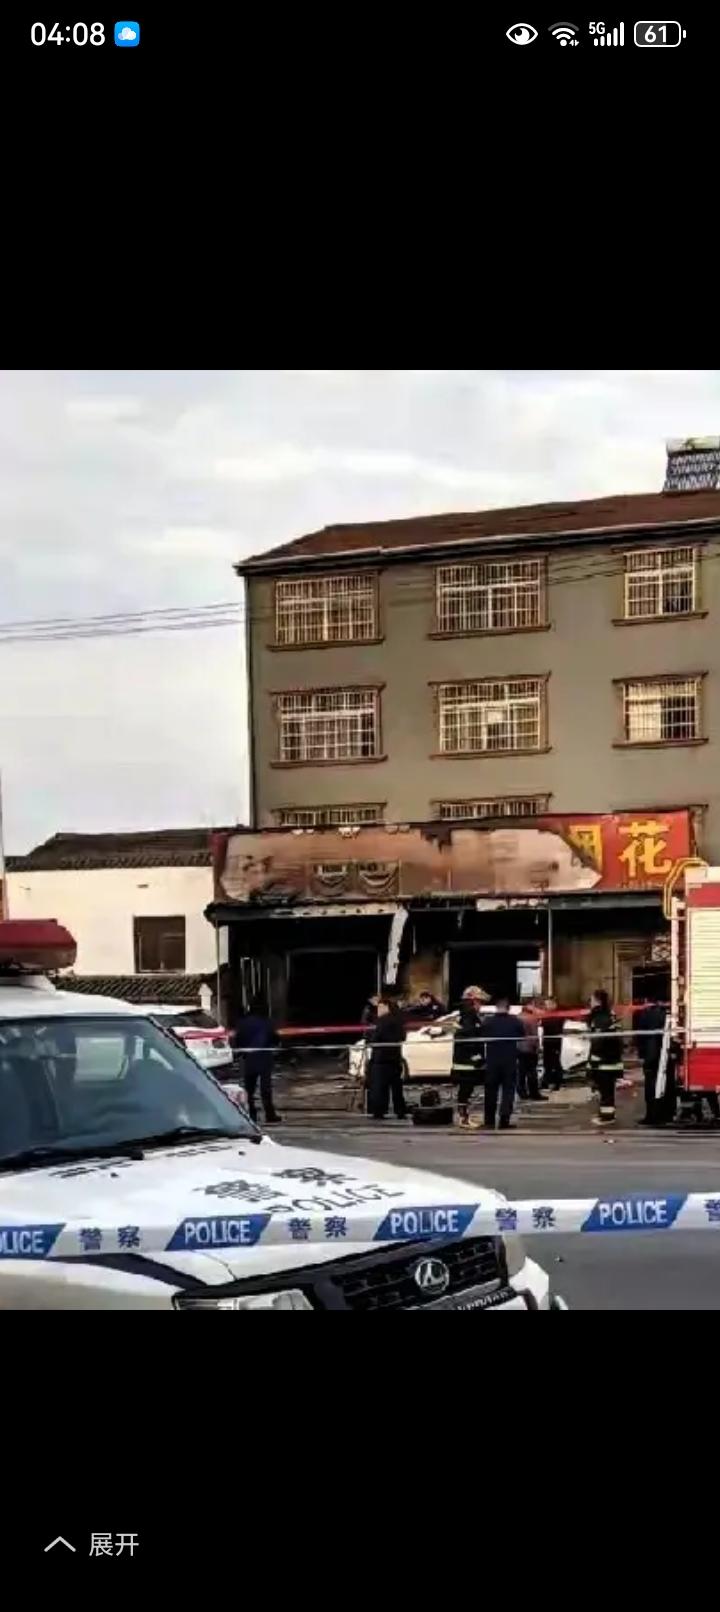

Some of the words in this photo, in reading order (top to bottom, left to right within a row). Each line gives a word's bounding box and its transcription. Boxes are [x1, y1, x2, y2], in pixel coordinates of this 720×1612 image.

[79, 1225, 140, 1250] 警察
[184, 1219, 250, 1244] POLICE
[288, 1216, 347, 1240] 警察
[390, 1208, 459, 1234] POLICE
[495, 1206, 556, 1231] 警察
[599, 1199, 667, 1226] POLICE
